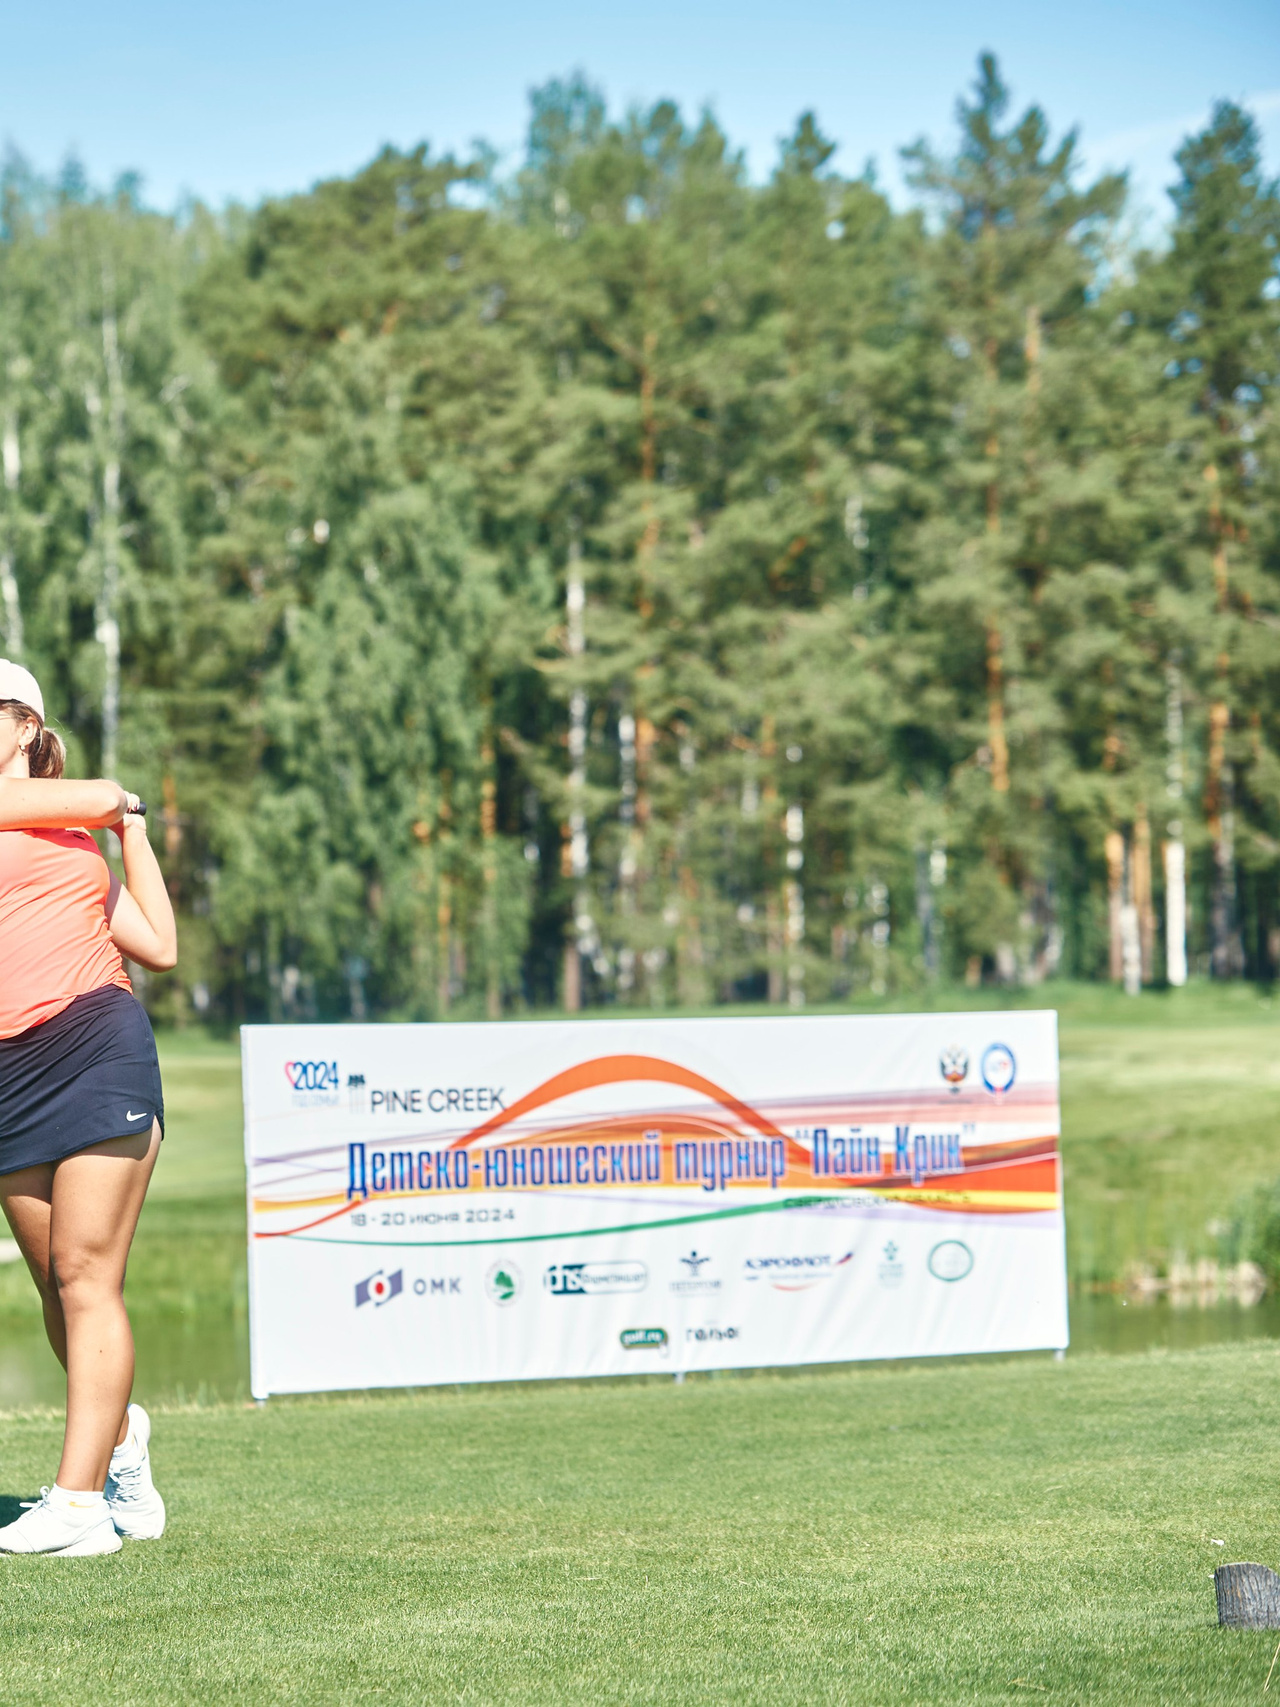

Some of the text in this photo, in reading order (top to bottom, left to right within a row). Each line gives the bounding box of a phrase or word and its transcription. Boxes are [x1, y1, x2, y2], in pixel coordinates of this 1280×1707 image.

[293, 1061, 339, 1090] 2024
[371, 1087, 506, 1114] PINE CREEK
[347, 1130, 662, 1200] Детско-юношеский
[674, 1136, 785, 1191] турнир
[381, 1212, 405, 1226] 20
[465, 1209, 516, 1223] 2024
